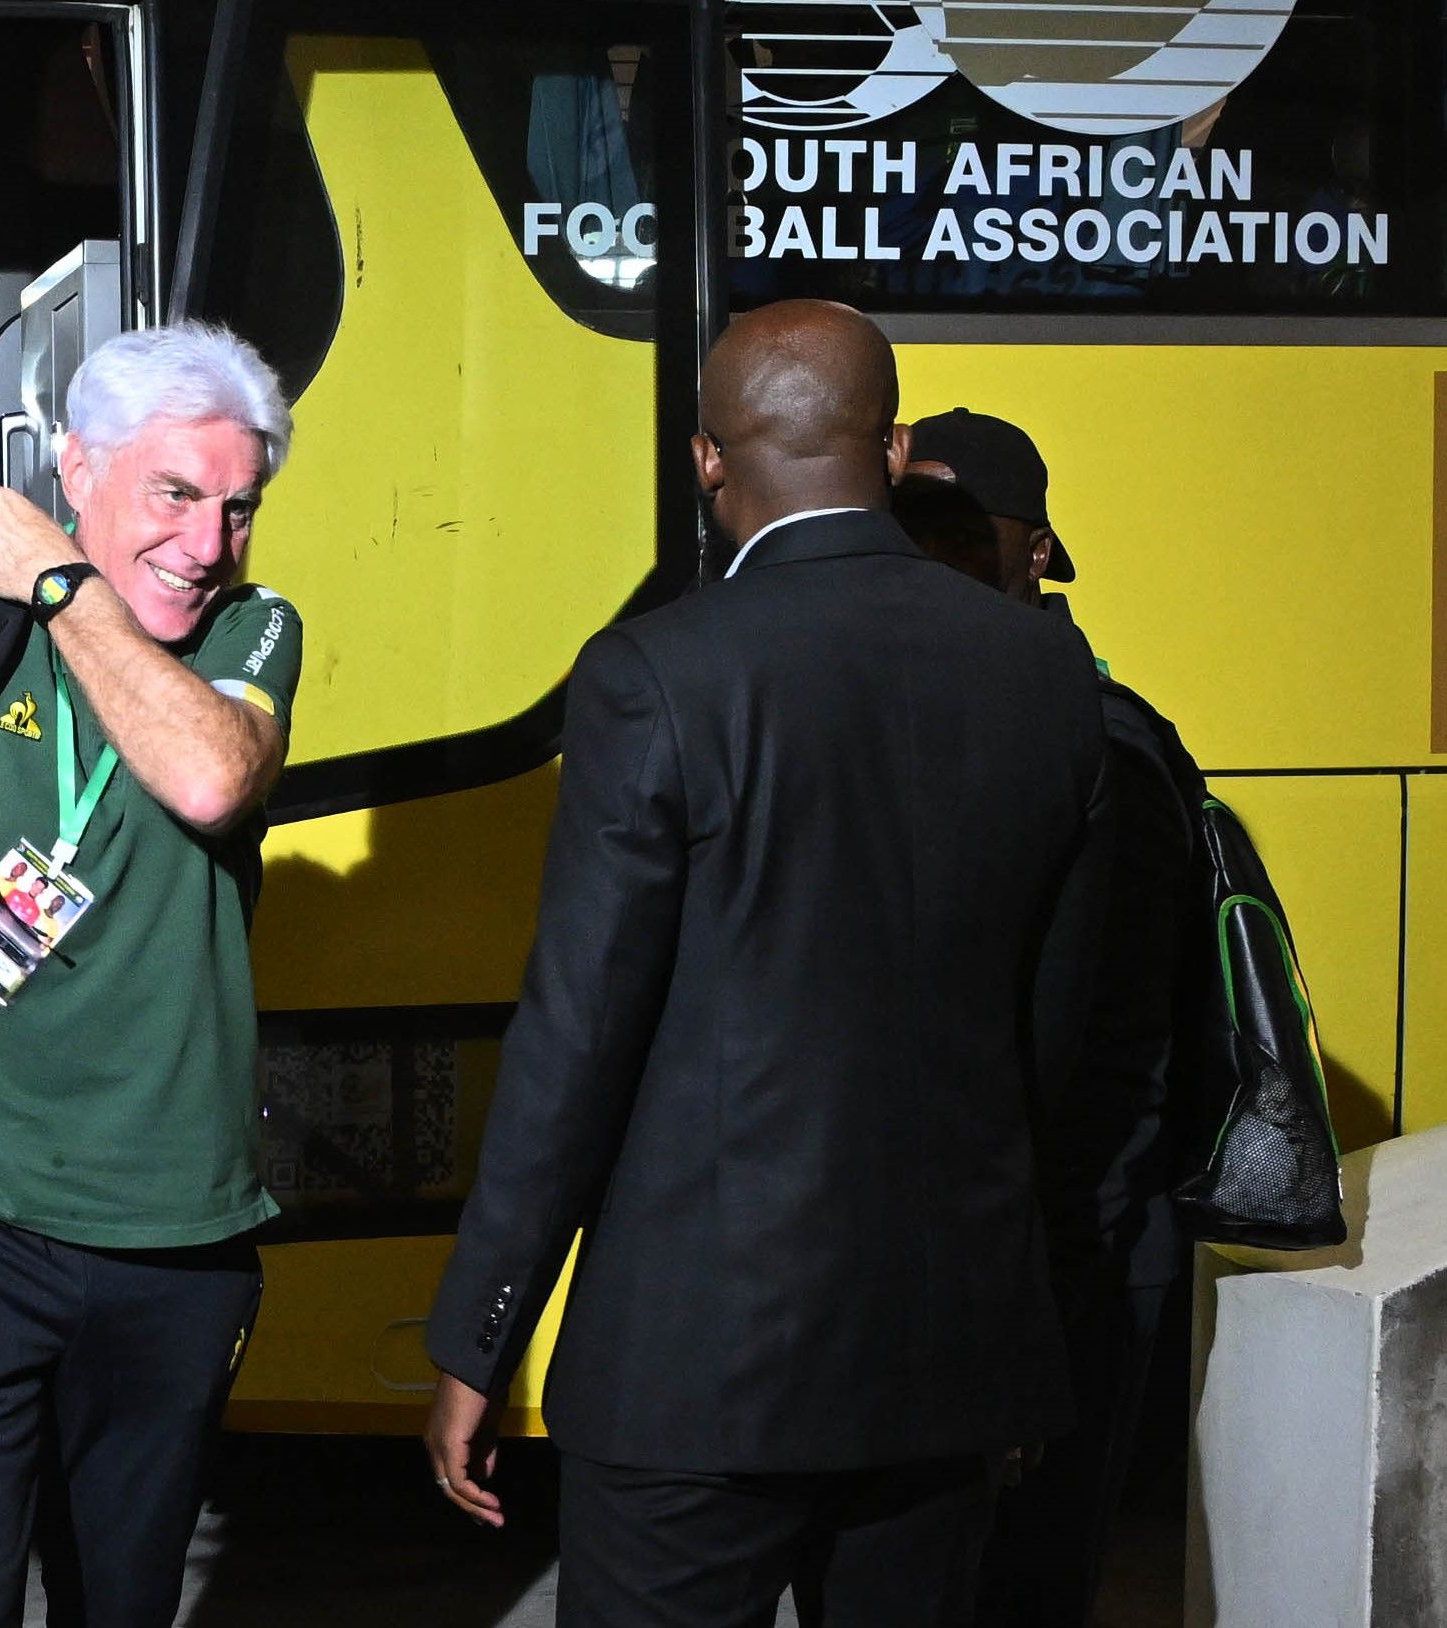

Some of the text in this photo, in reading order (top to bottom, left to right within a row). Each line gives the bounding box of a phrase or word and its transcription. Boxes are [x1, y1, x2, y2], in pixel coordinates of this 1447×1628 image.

[727, 138, 1252, 200] OUTH AFRICAN
[524, 203, 1388, 264] FOOBALL ASSOCIATION
